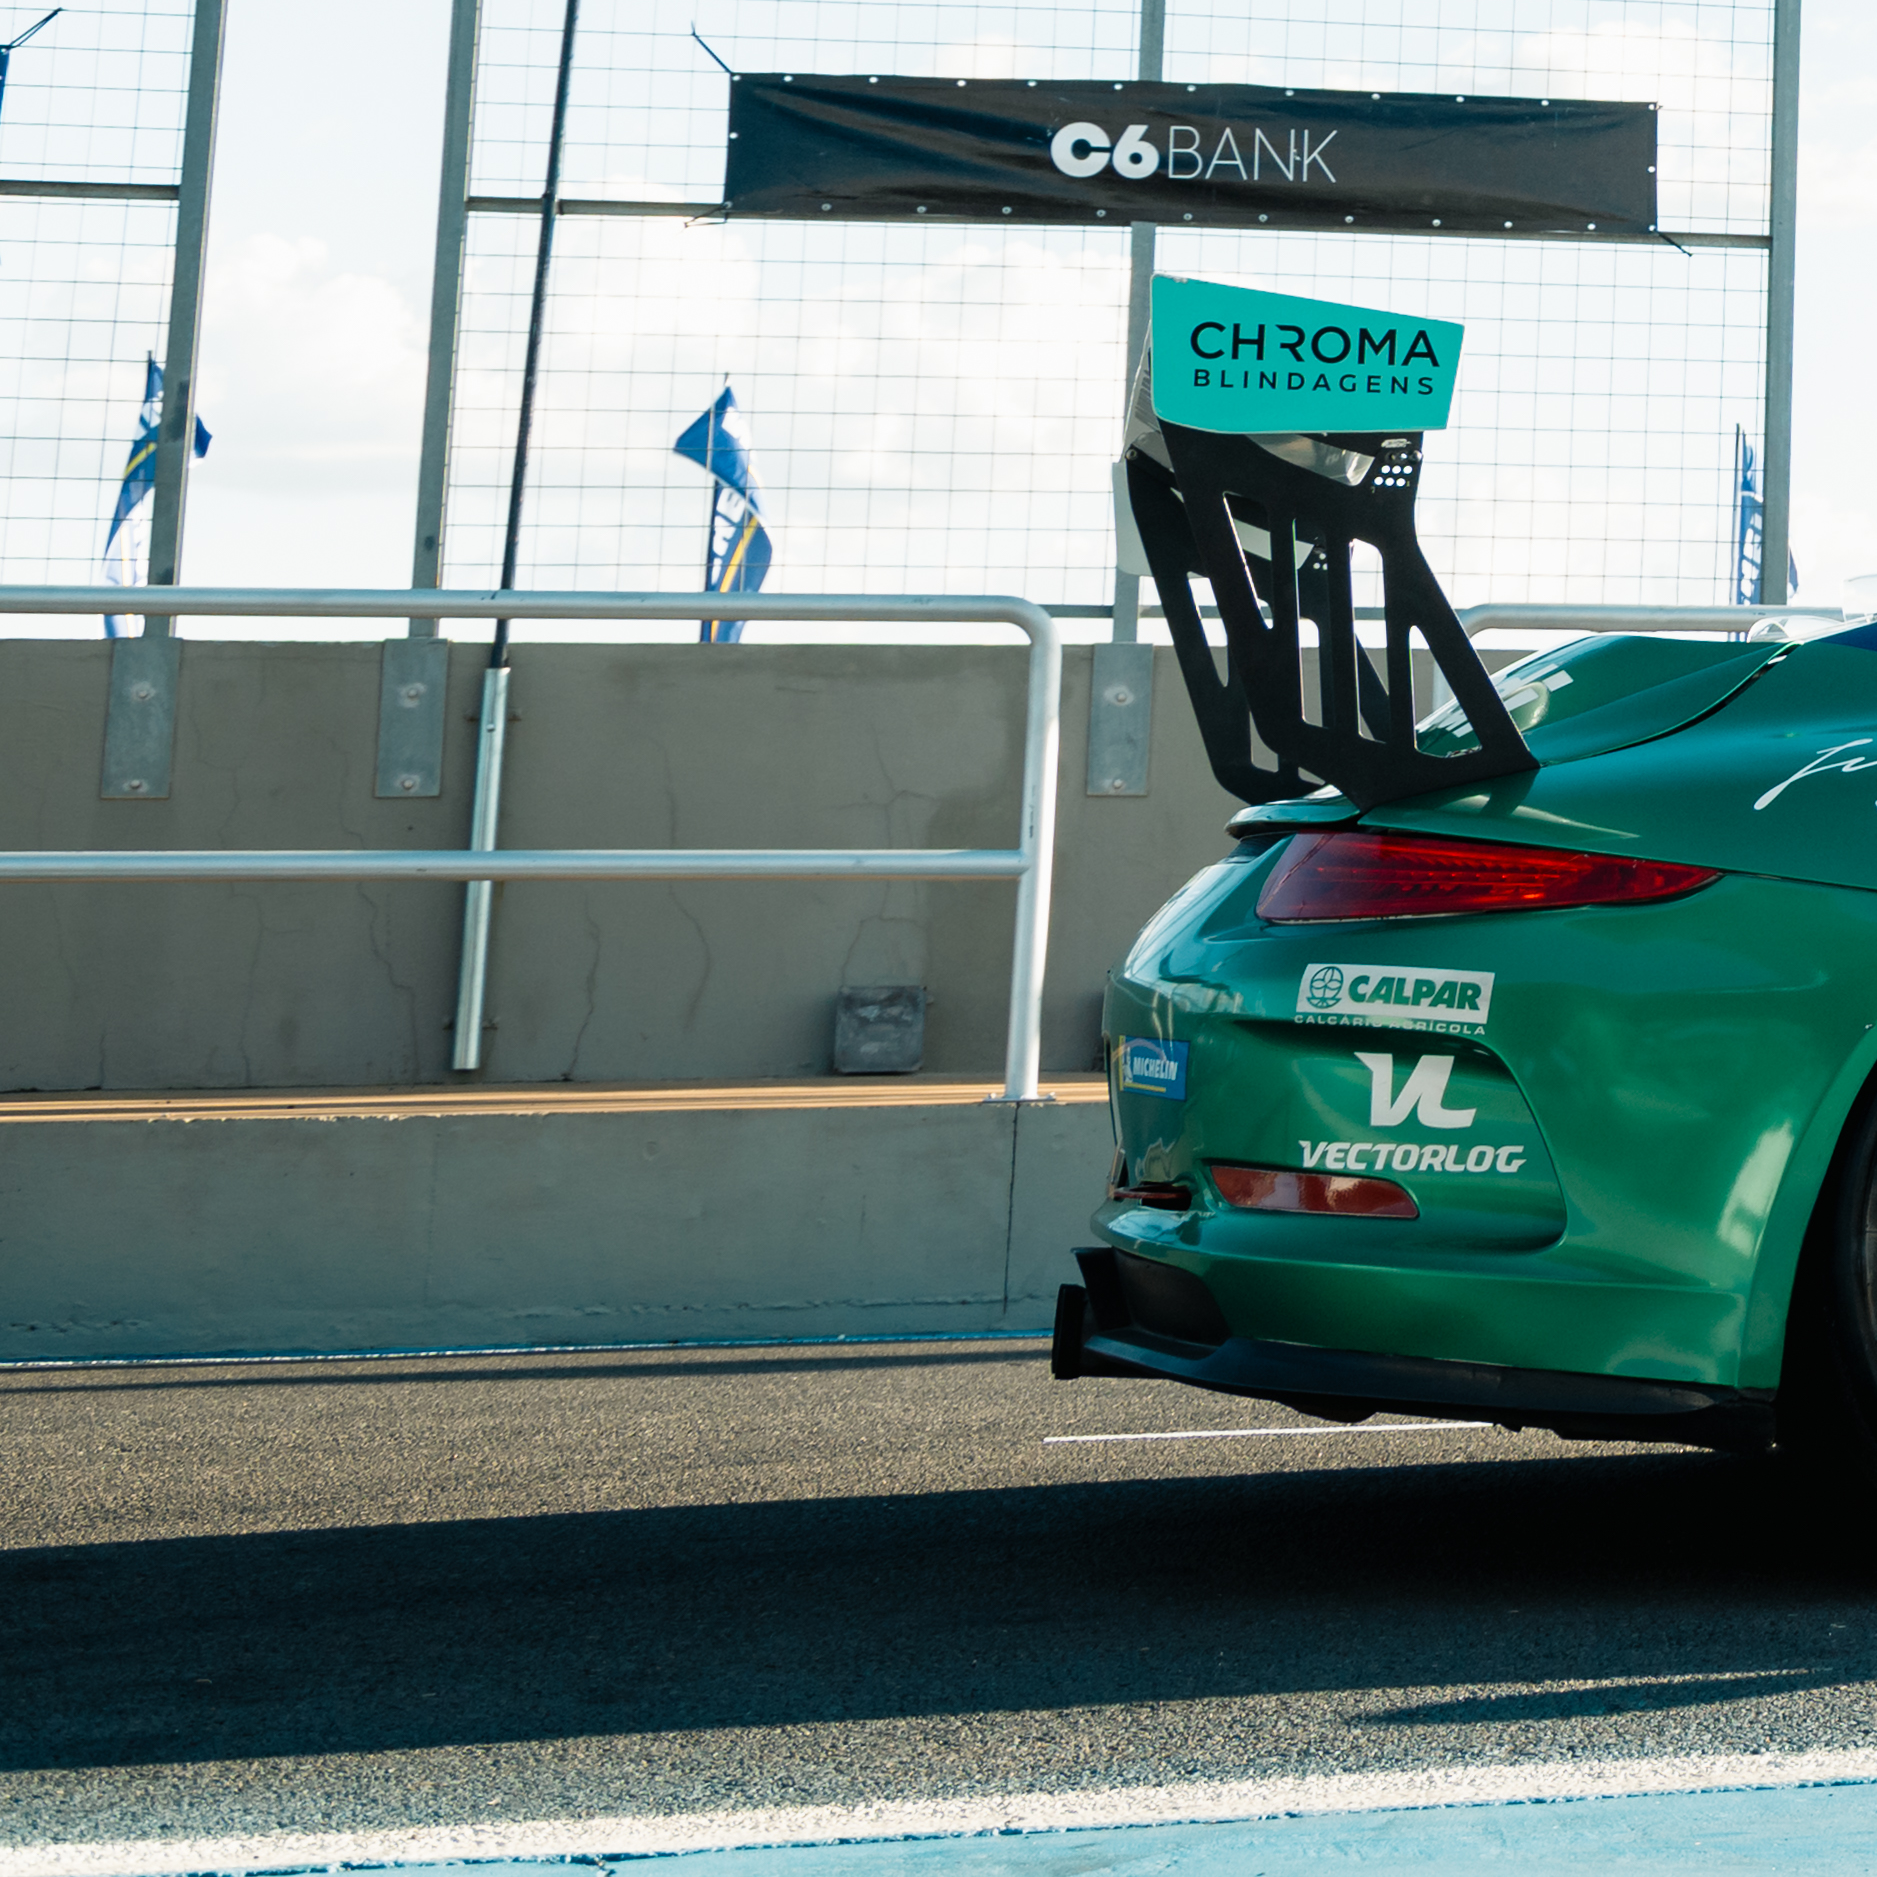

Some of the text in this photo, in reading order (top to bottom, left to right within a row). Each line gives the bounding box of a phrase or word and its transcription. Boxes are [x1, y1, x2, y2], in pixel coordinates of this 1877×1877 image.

[1190, 321, 1440, 367] CHROMA
[1193, 369, 1434, 395] BLINDAGENS
[1347, 974, 1482, 1011] CALPAR
[1133, 1056, 1179, 1081] MICHELIN
[1298, 1139, 1527, 1174] VECTORLOG
